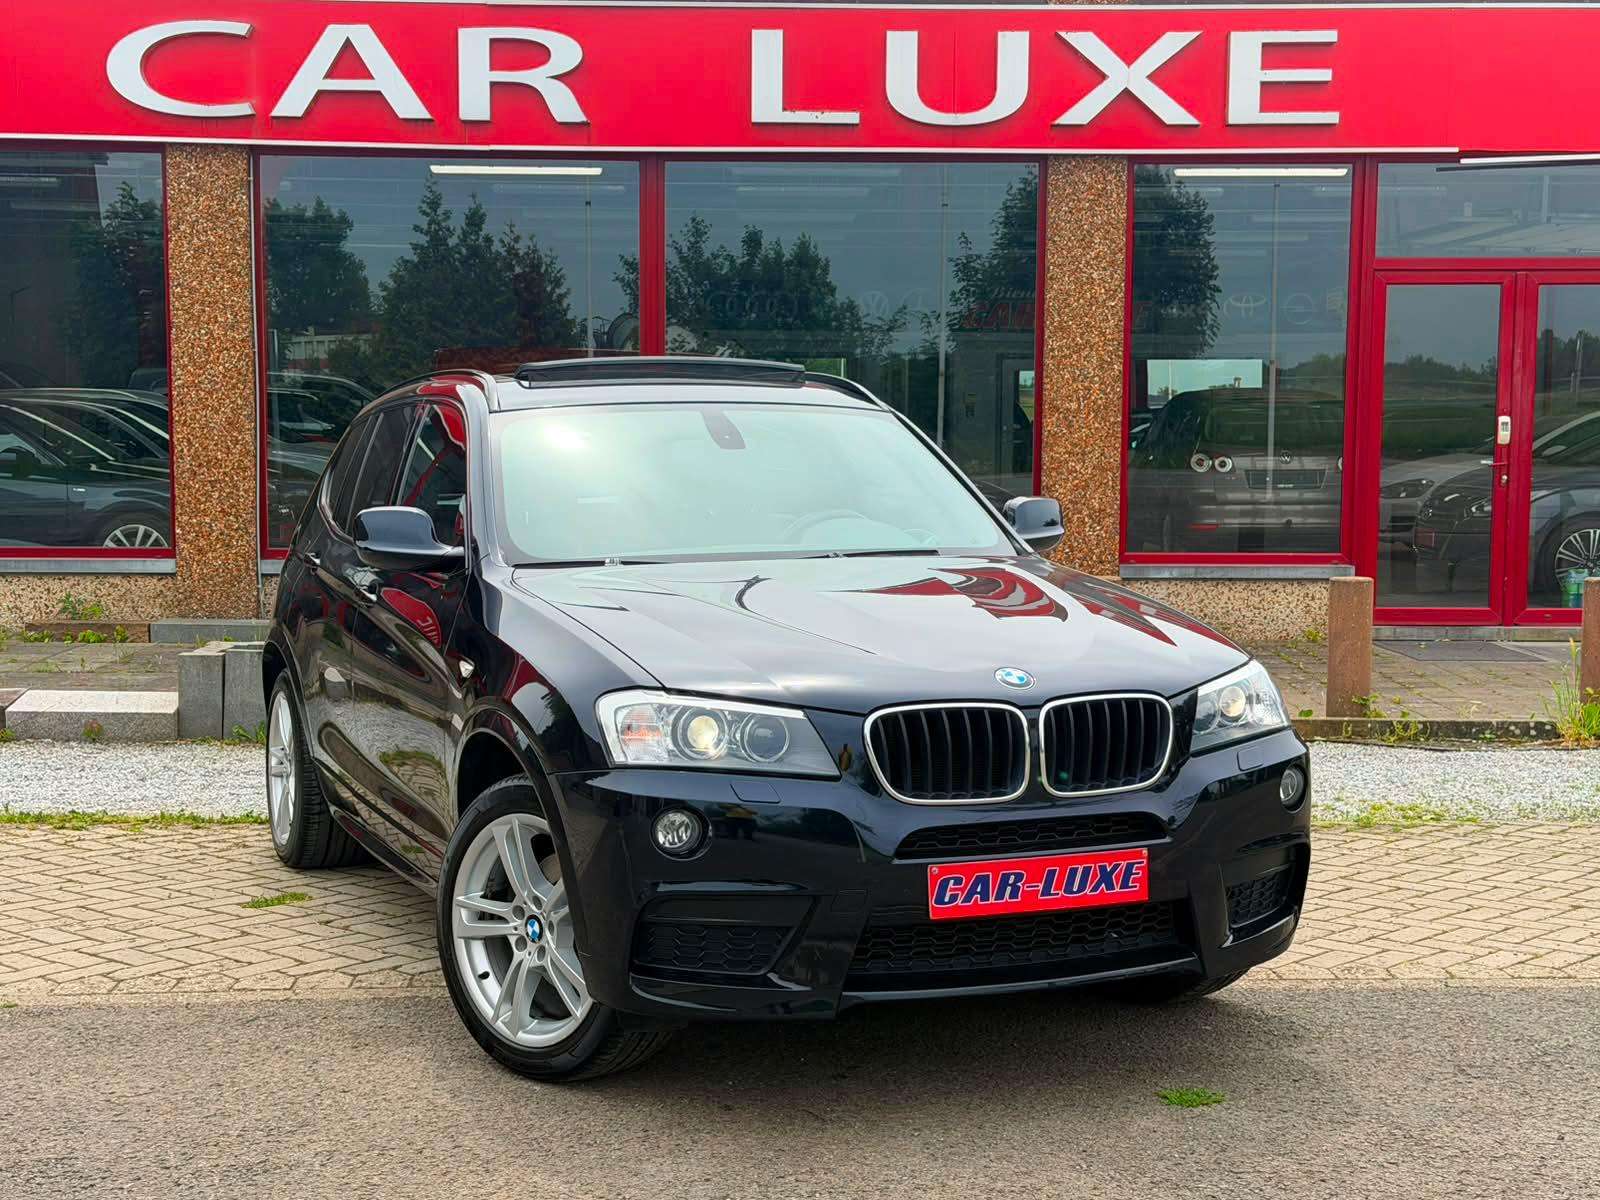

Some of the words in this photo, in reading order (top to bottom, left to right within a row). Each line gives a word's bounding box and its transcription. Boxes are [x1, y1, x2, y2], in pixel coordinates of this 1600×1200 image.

[106, 20, 590, 124] CAR
[751, 29, 1340, 127] LUXE
[932, 859, 1146, 907] CAR-LUXE
